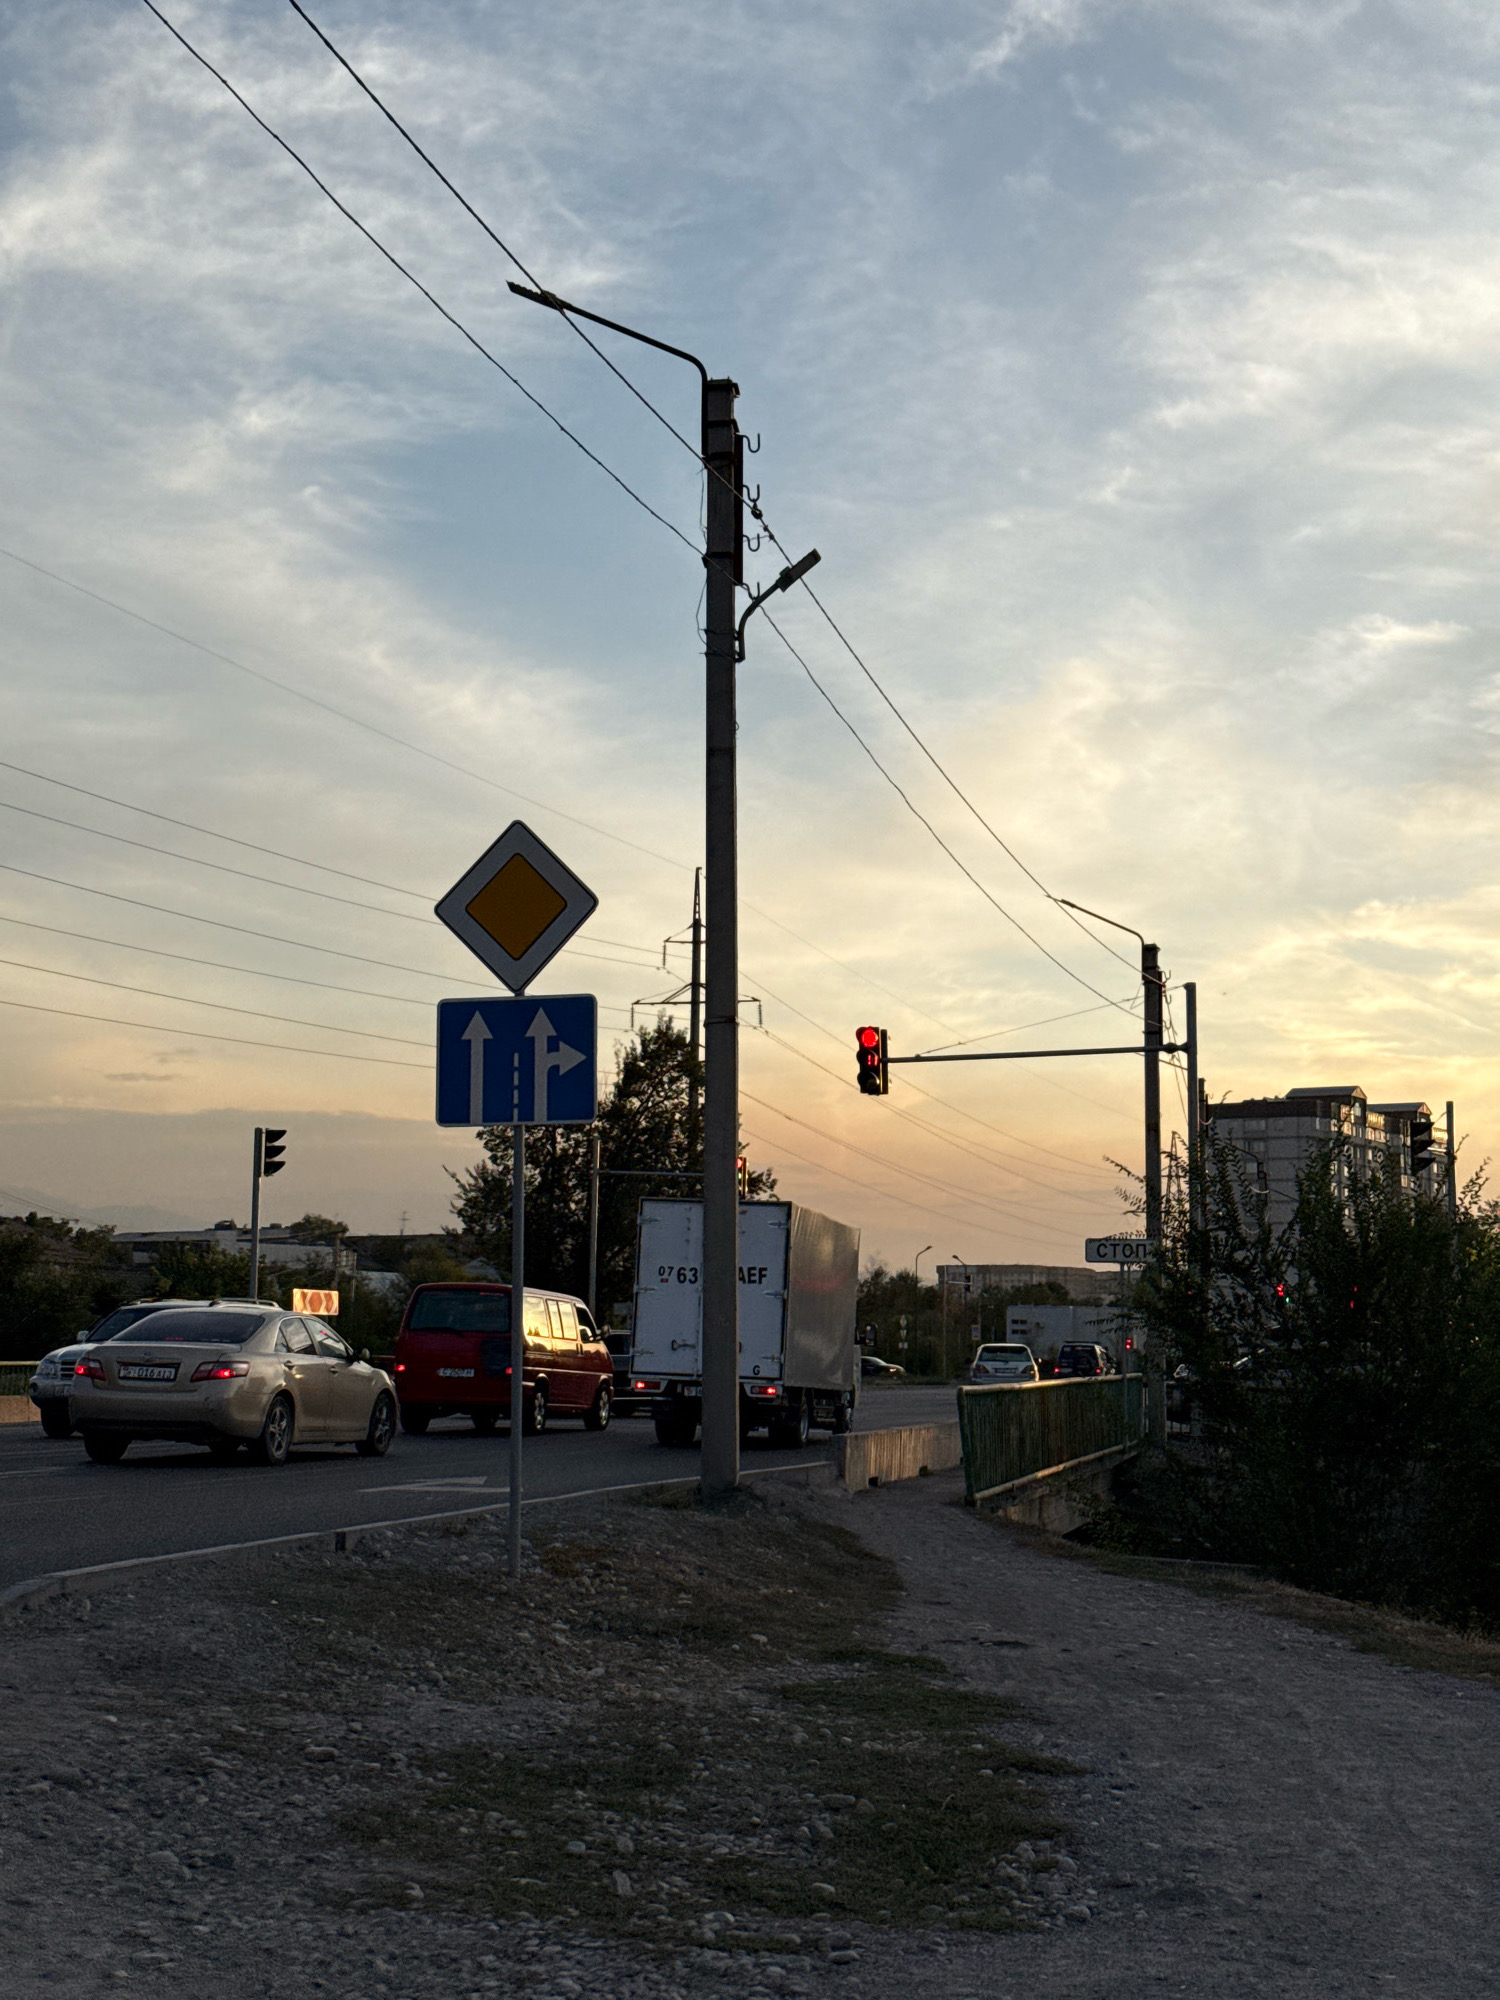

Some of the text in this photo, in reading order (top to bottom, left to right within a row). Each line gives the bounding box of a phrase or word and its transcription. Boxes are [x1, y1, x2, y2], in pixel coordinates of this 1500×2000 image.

[1096, 1242, 1147, 1259] СТОП
[657, 1265, 675, 1277] 07
[738, 1266, 769, 1285] AEF
[752, 1364, 761, 1376] G
